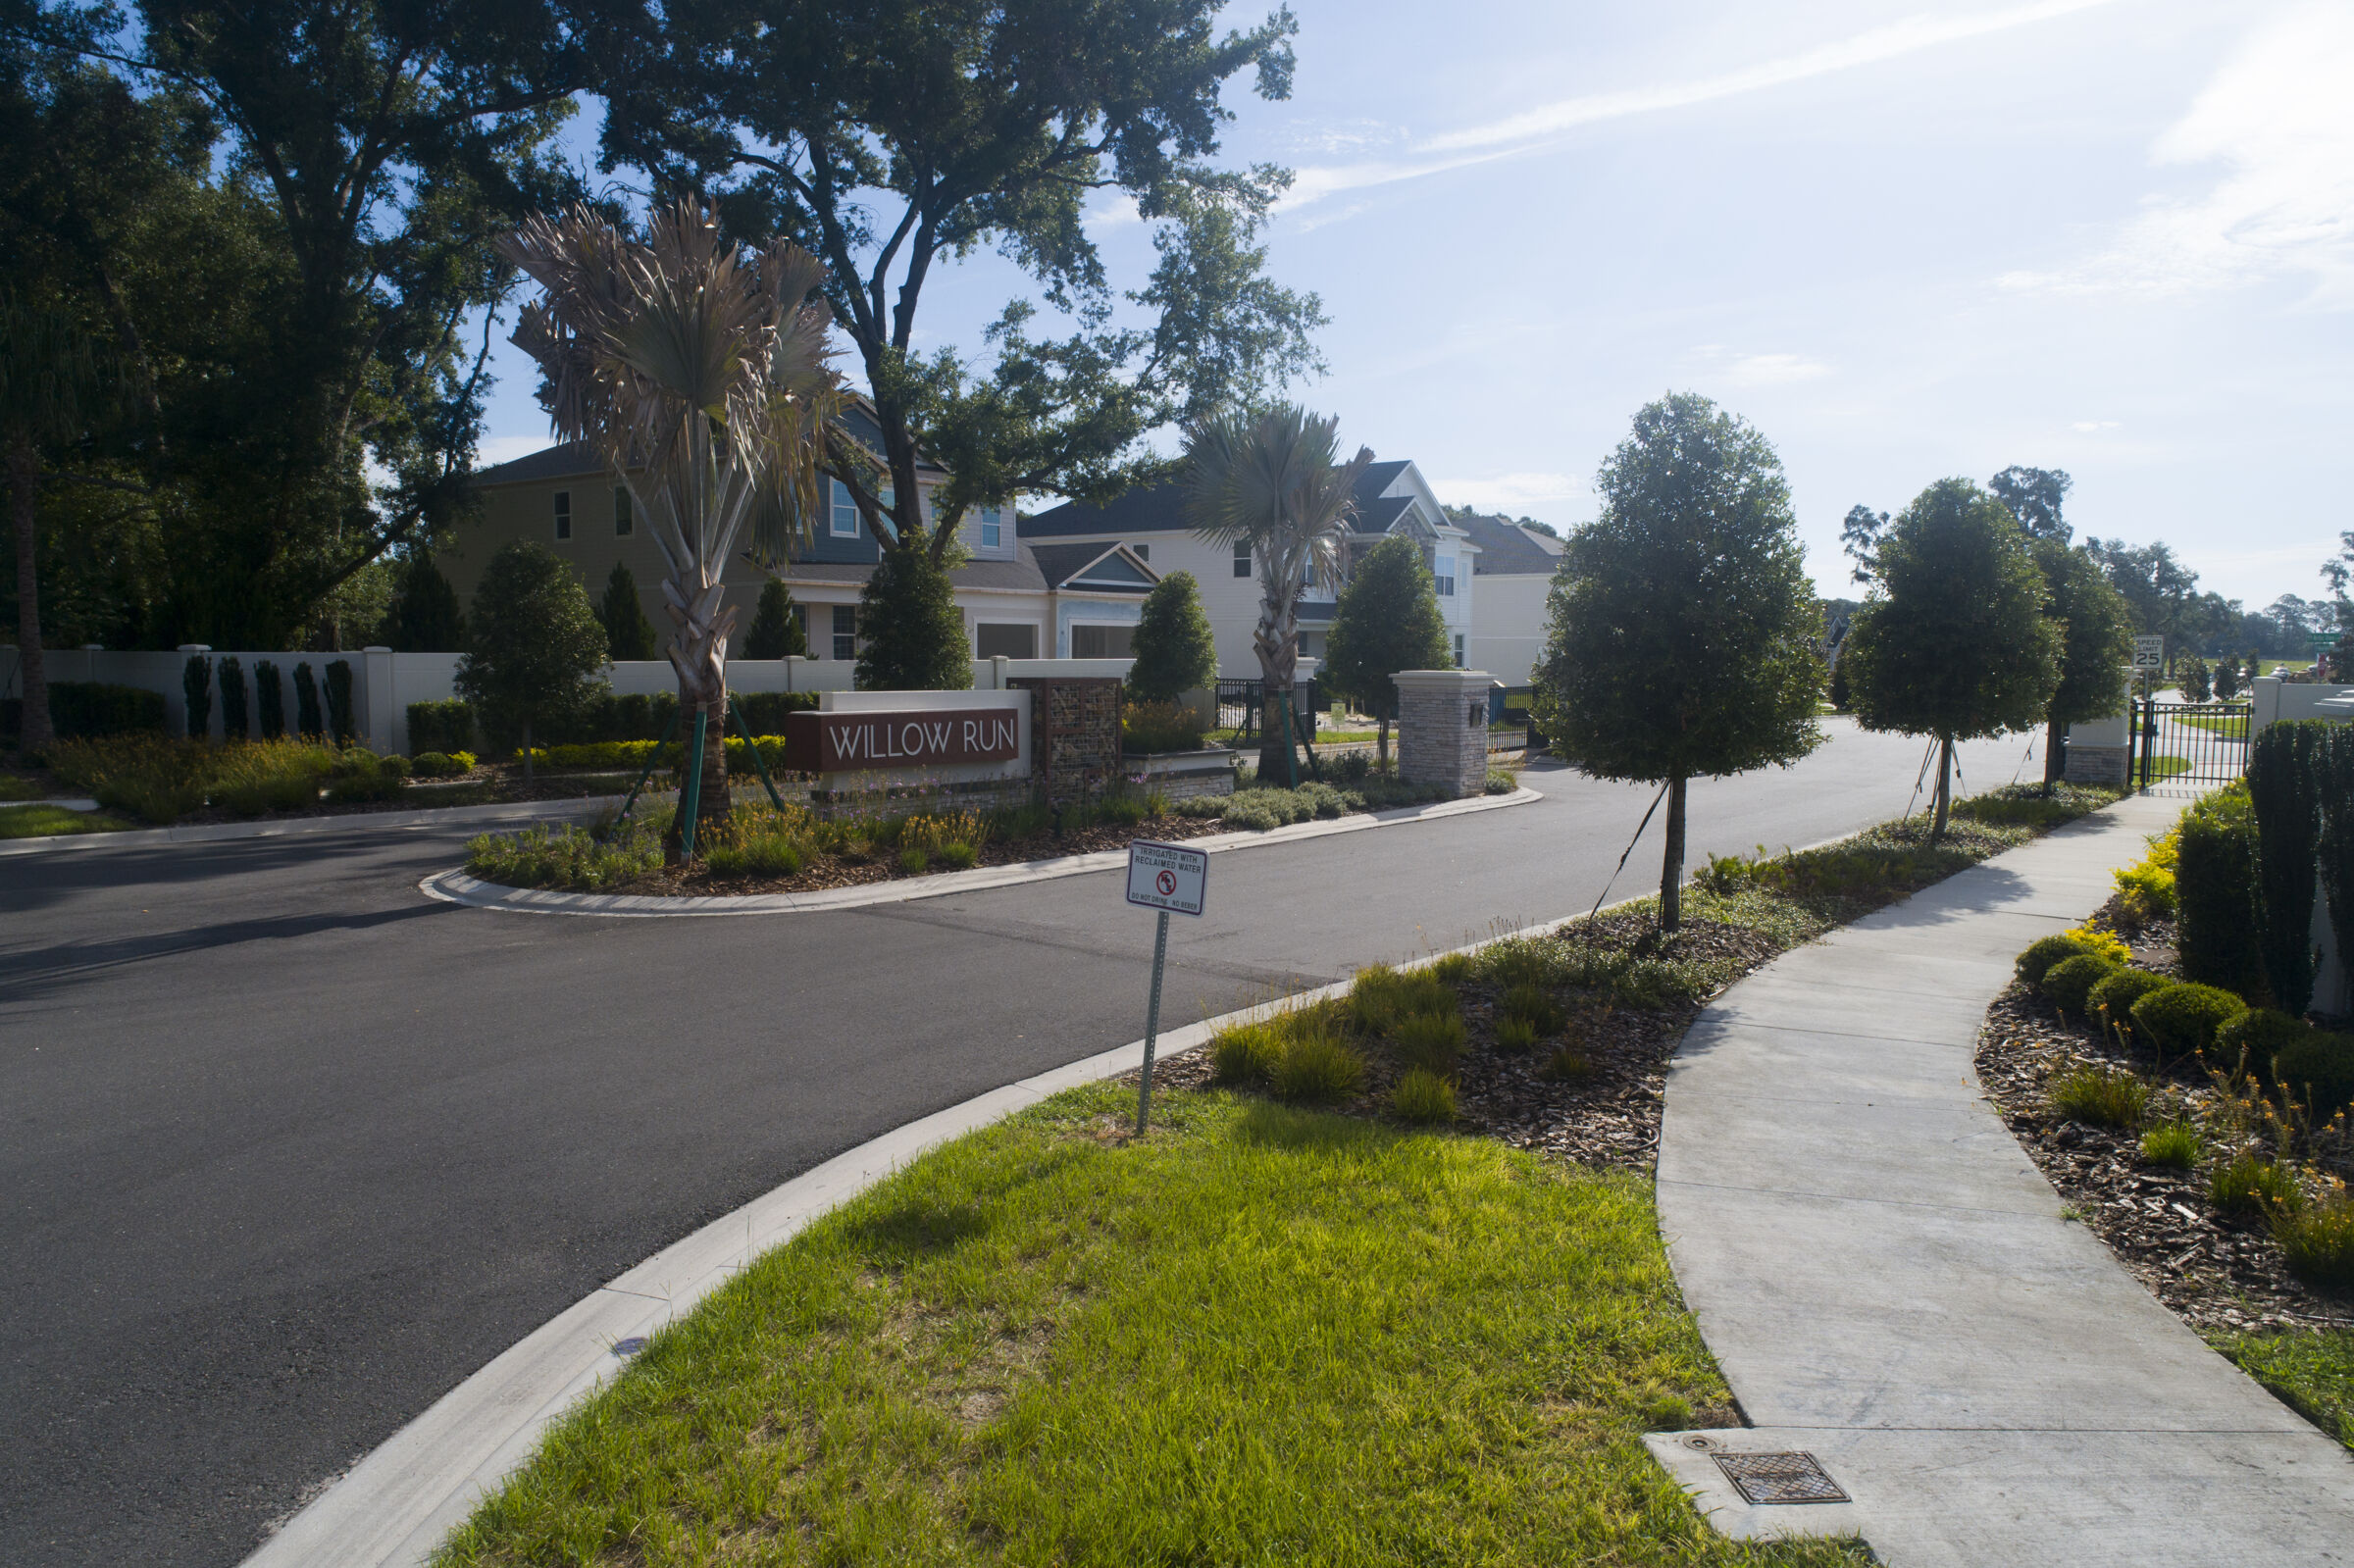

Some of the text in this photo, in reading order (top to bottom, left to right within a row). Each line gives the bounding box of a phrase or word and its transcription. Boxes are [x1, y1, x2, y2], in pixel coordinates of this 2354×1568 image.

[2136, 653, 2160, 665] 25
[829, 719, 1014, 760] WILLOW RUN
[1140, 847, 1198, 863] IRRIGATED WITH
[1135, 855, 1202, 874] RECLAIMED WATER
